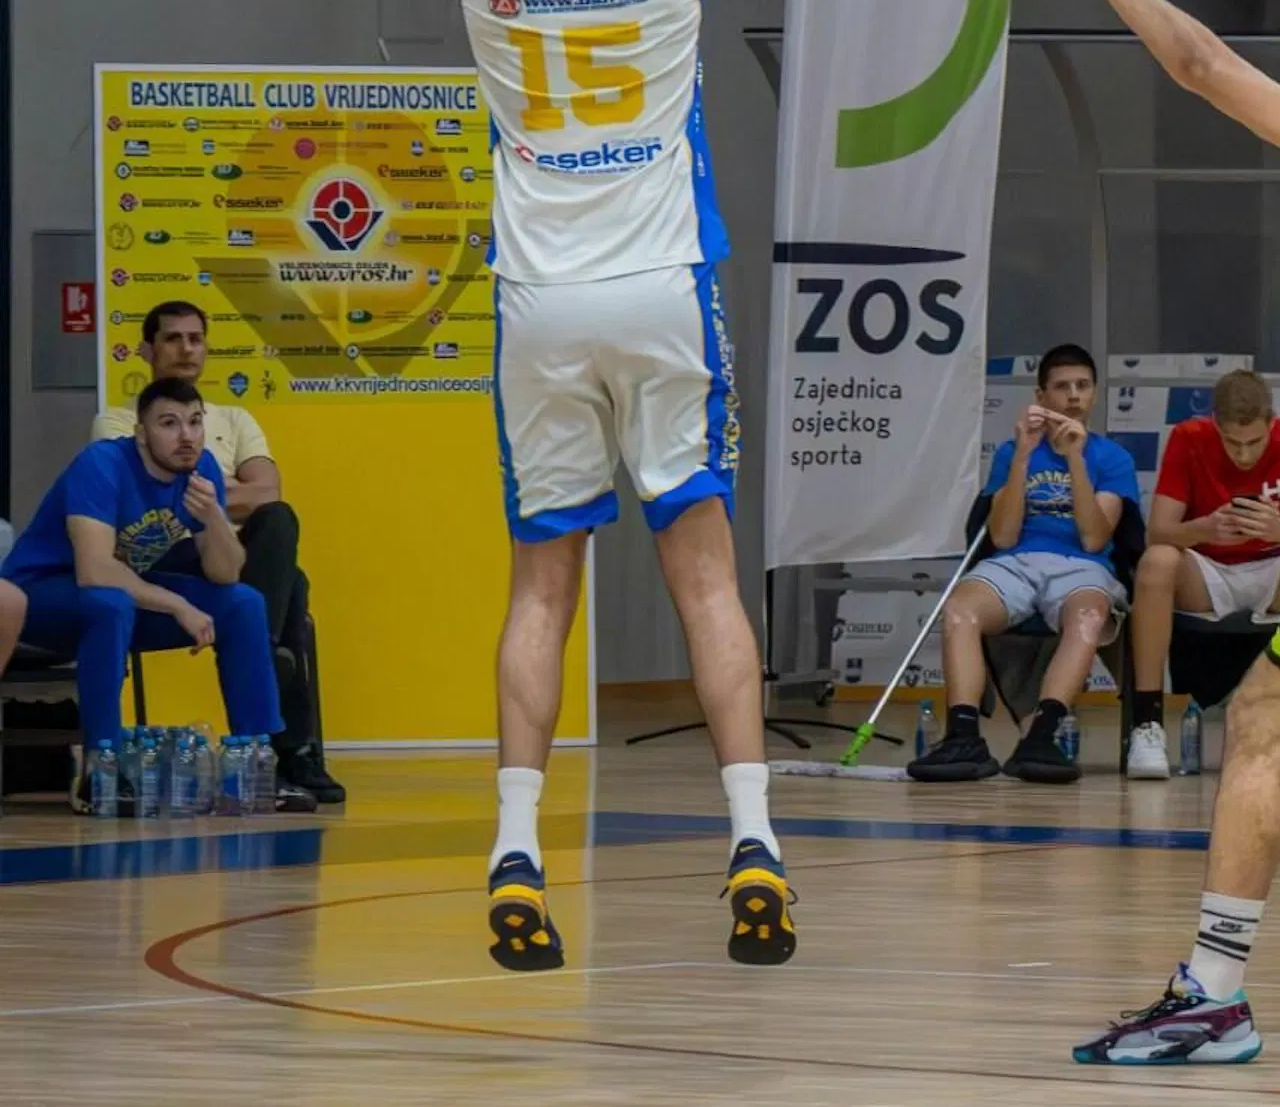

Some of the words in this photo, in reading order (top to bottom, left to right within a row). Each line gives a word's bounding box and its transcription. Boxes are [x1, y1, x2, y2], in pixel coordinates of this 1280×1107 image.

[508, 21, 646, 131] 15
[131, 82, 256, 107] BASKETBALL
[264, 84, 315, 108] CLUB
[324, 84, 477, 110] VRIJEDNOSNICE
[279, 266, 413, 282] www.vros.hr
[794, 278, 965, 355] ZOS
[793, 377, 903, 406] Zajednica
[791, 410, 892, 439] osječkog
[790, 445, 863, 471] sporta
